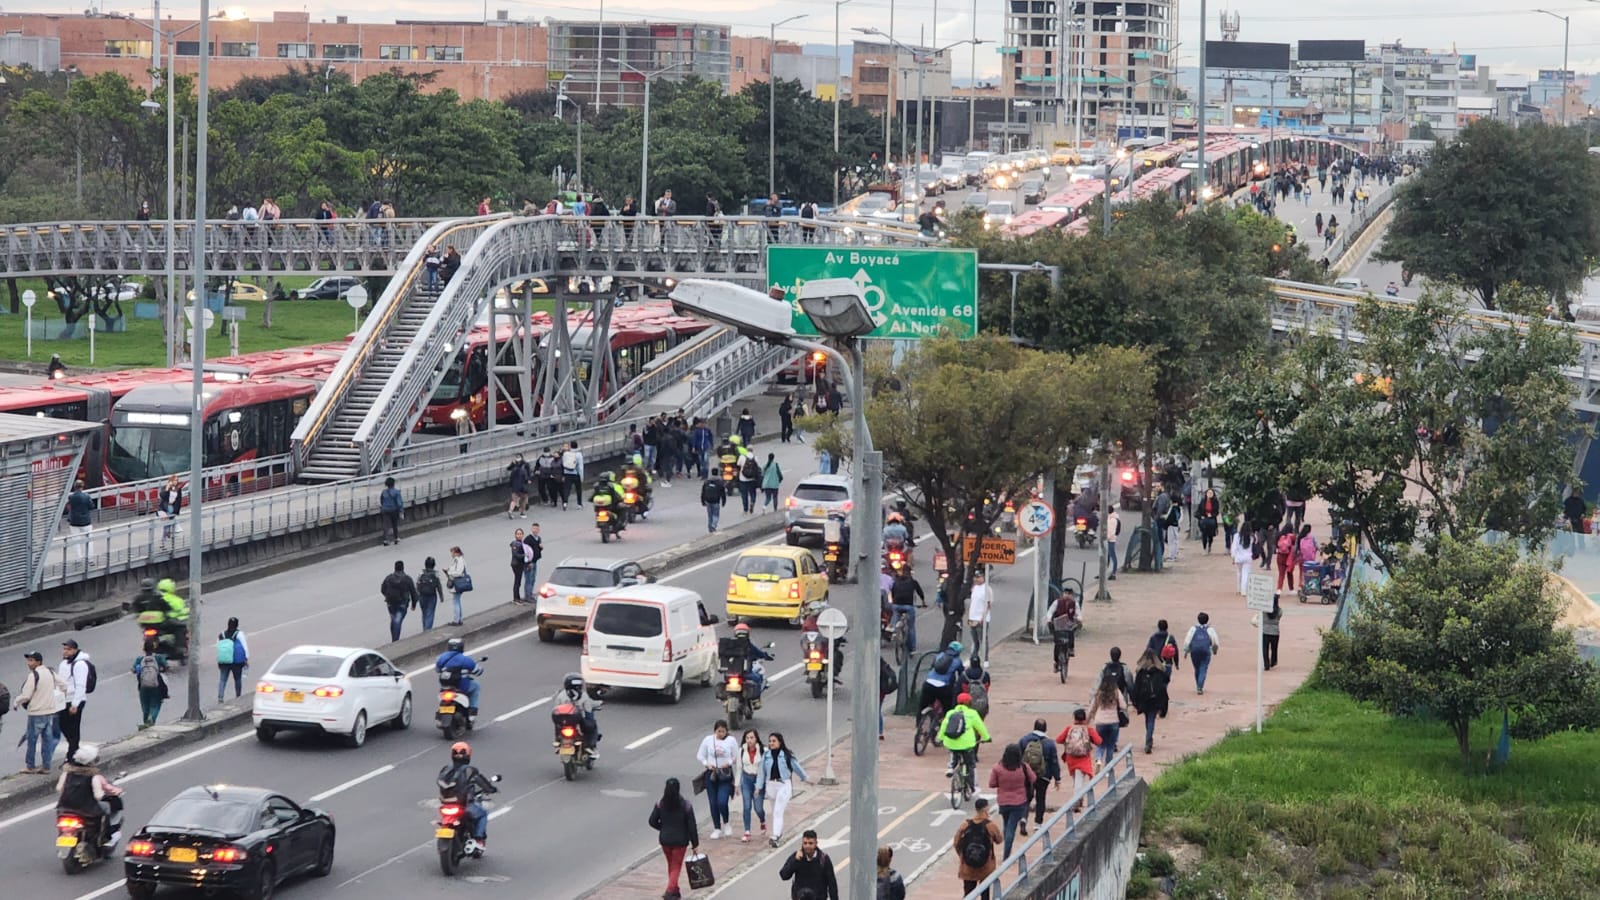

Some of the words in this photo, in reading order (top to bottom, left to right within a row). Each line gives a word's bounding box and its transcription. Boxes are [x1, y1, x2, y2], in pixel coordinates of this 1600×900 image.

[824, 251, 844, 264] Av
[850, 252, 899, 267] Boyacá
[891, 303, 947, 317] Avenida
[952, 305, 973, 317] 68
[890, 320, 906, 333] Al
[969, 542, 1008, 550] SNDERO
